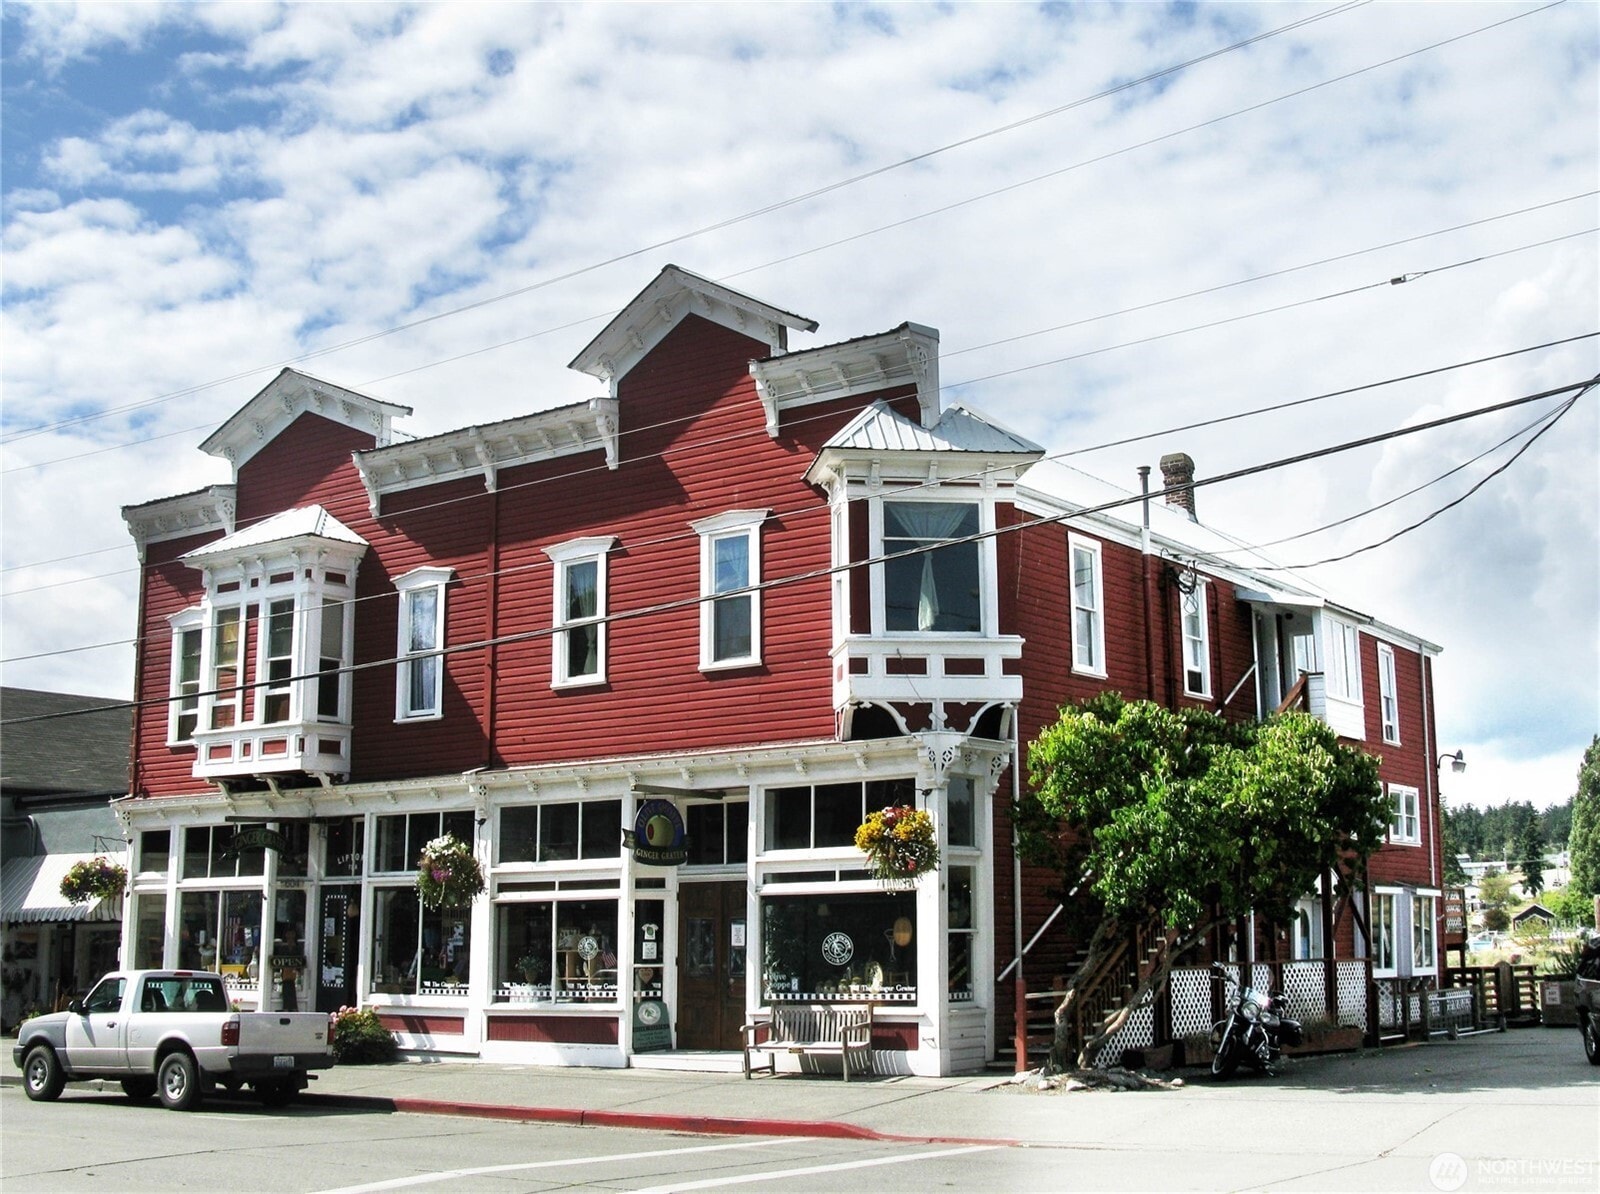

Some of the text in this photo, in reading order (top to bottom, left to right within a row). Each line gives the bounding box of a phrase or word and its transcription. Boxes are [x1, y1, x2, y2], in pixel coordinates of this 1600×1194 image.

[636, 848, 684, 859] GINGER GRATER
[273, 958, 303, 966] OPEN
[895, 984, 916, 992] Grater
